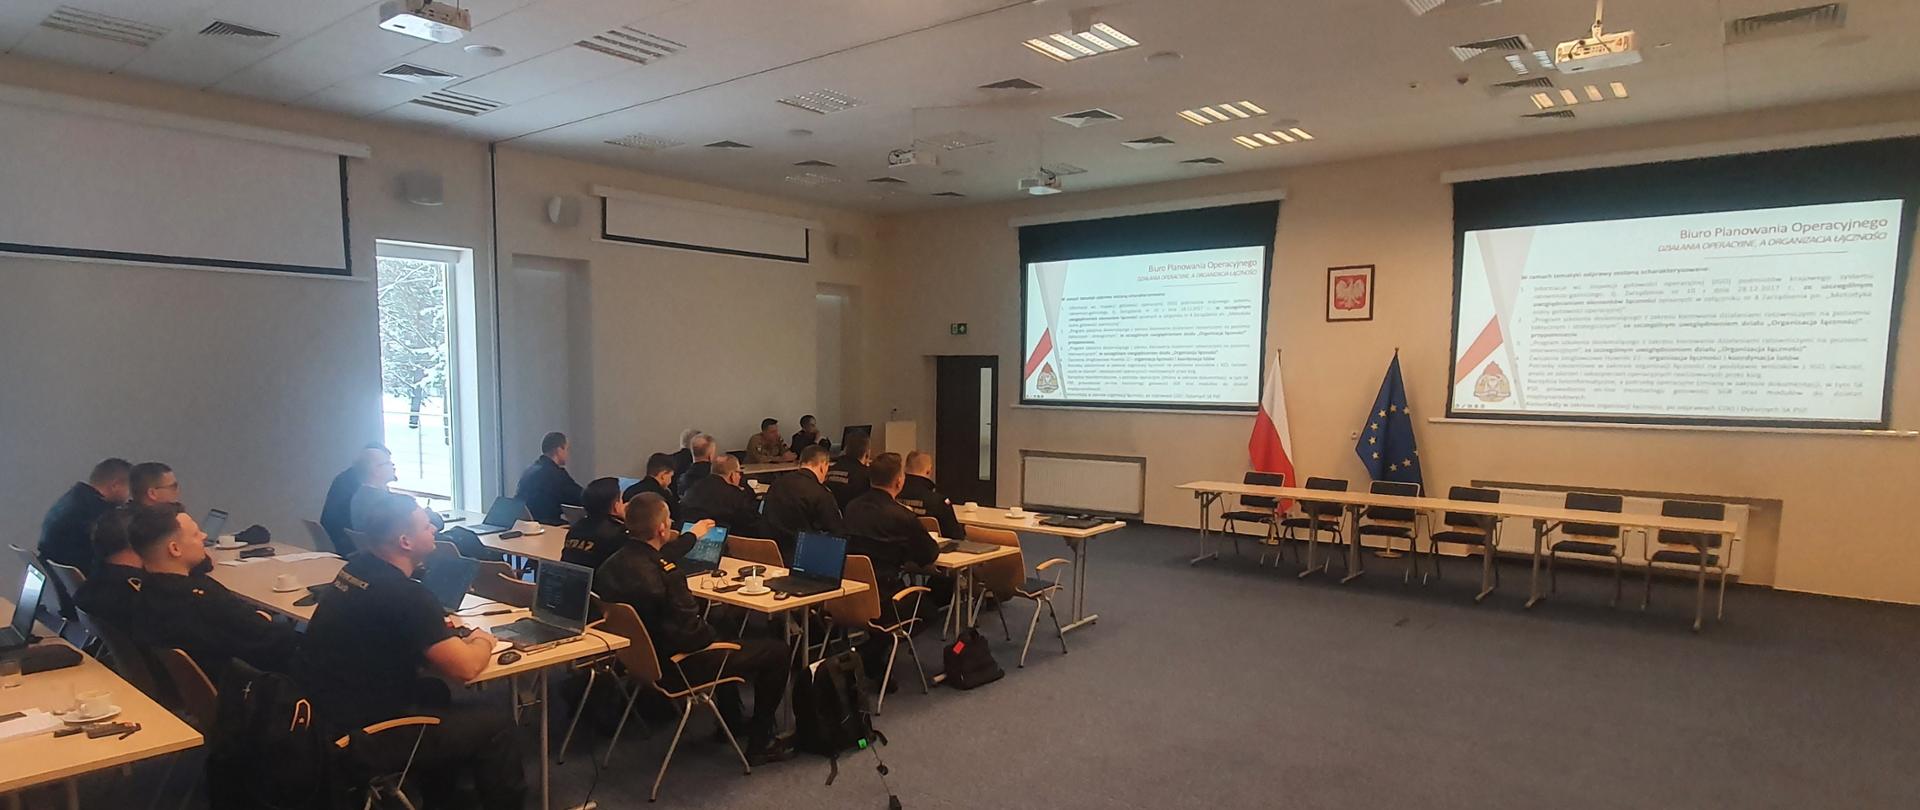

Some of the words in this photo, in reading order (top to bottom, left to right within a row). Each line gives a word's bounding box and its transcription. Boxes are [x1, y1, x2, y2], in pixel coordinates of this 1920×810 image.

[1680, 229, 1711, 239] Biuro
[1715, 226, 1787, 238] Planowania
[1792, 217, 1888, 234] Operacyjnego
[1759, 239, 1767, 247] A
[1767, 235, 1833, 247] ORGANIZACJA
[1148, 265, 1166, 273] Biuro
[1167, 263, 1206, 272] Planowania
[1207, 260, 1257, 270] Operacyjnego
